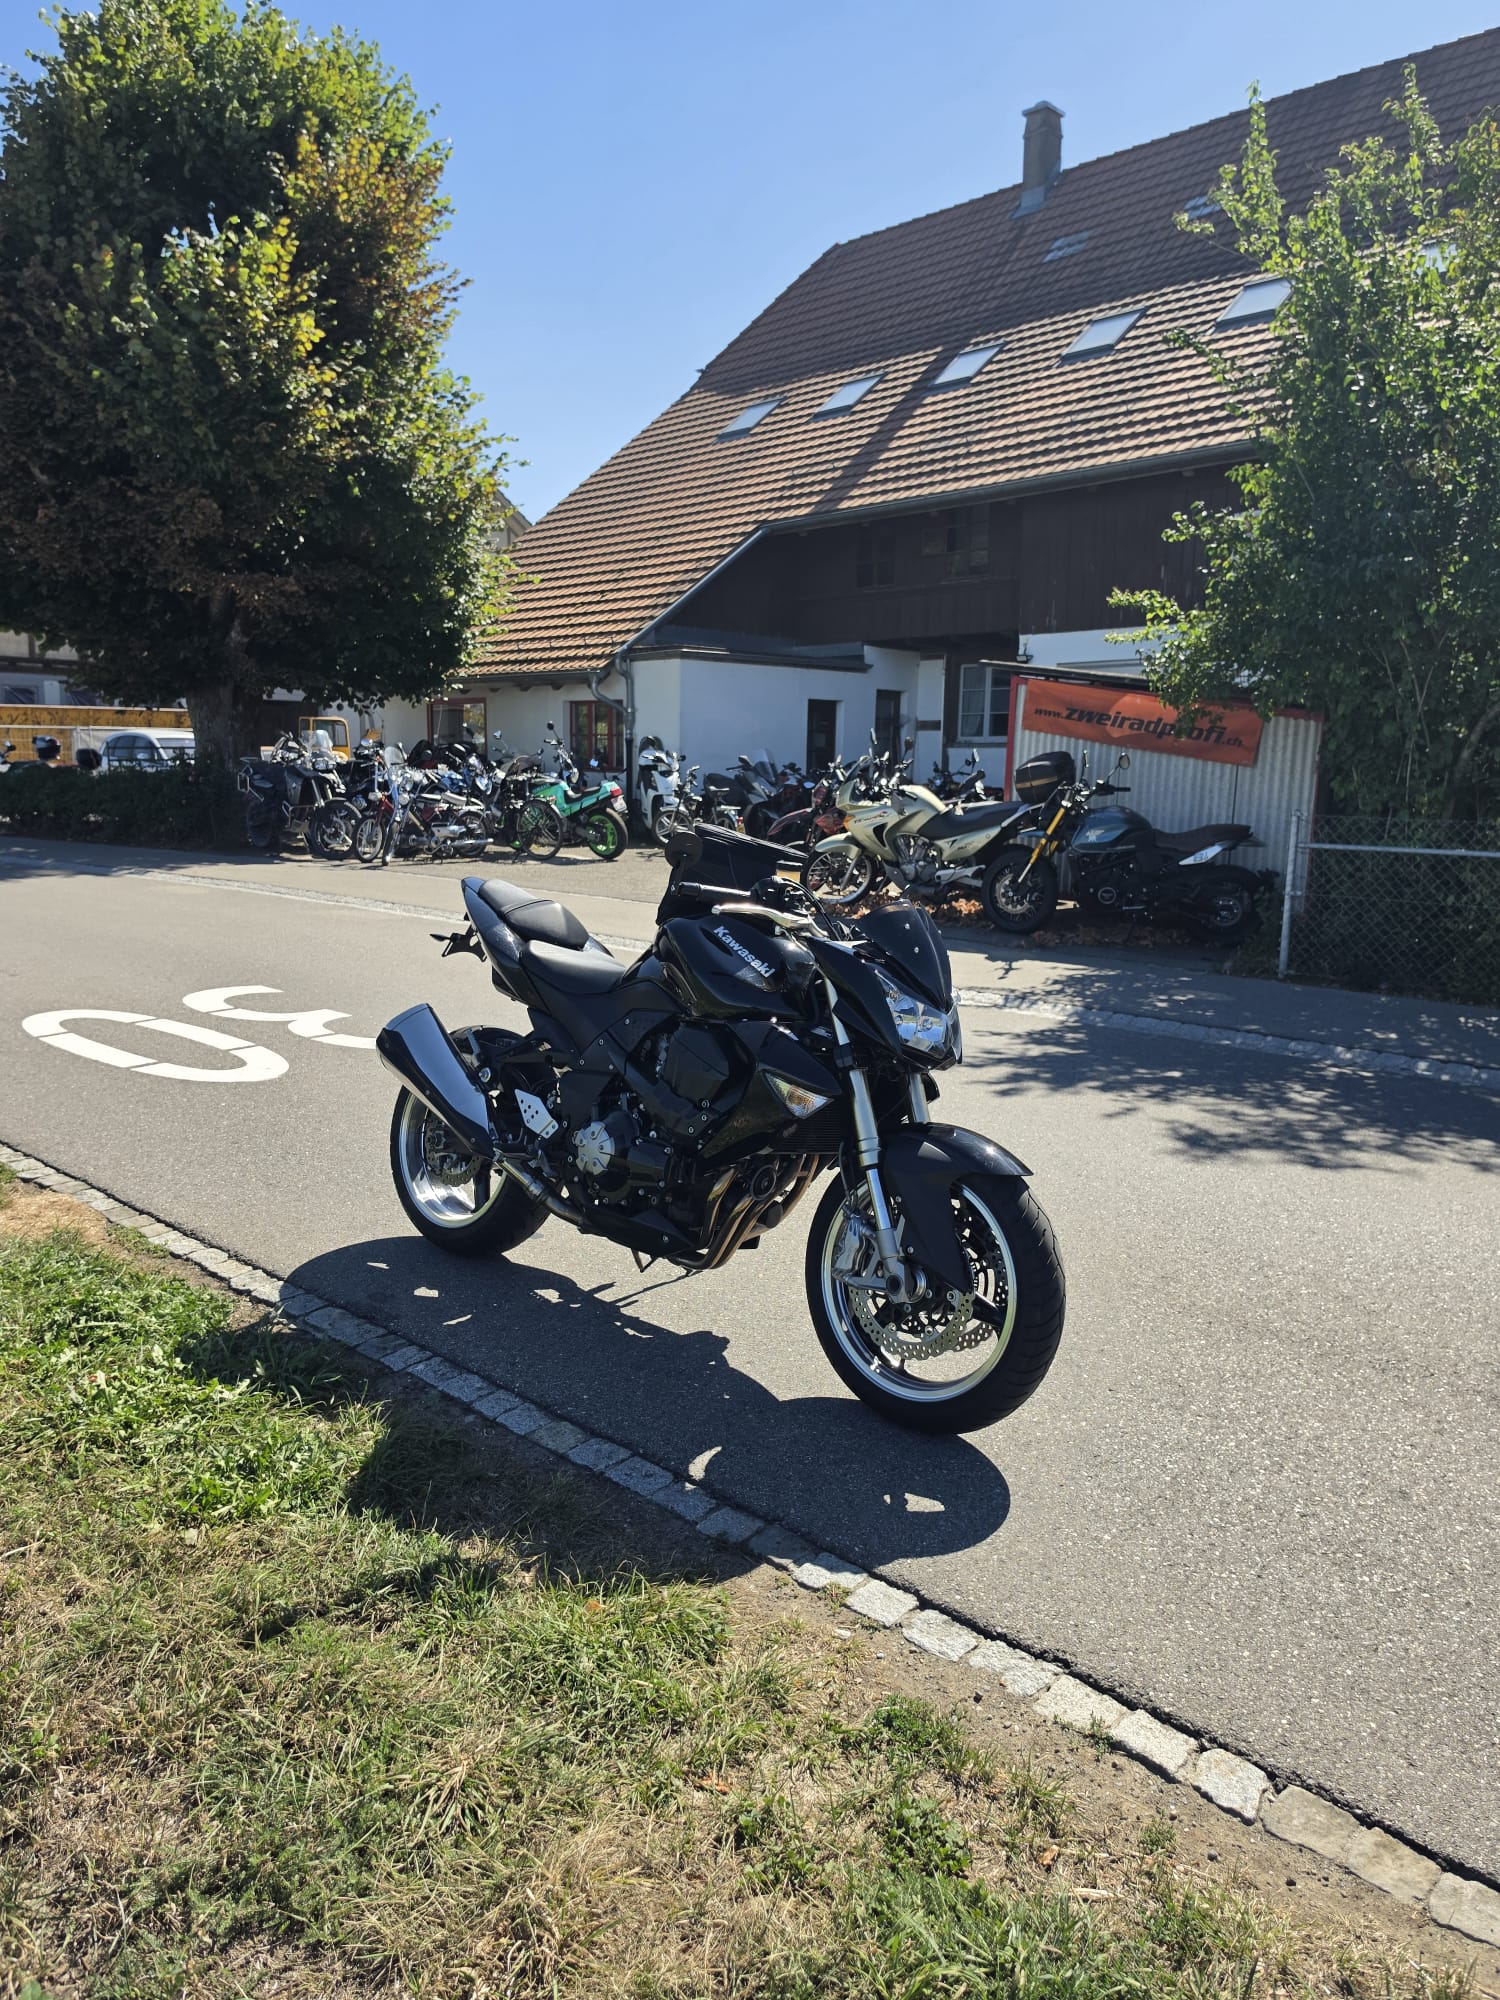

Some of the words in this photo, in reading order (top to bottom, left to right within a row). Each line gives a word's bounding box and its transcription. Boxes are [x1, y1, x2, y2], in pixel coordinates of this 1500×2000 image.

[1034, 707, 1243, 747] www.zweiradpofi.ch
[713, 925, 776, 978] Kawasaki
[22, 985, 376, 1082] 30
